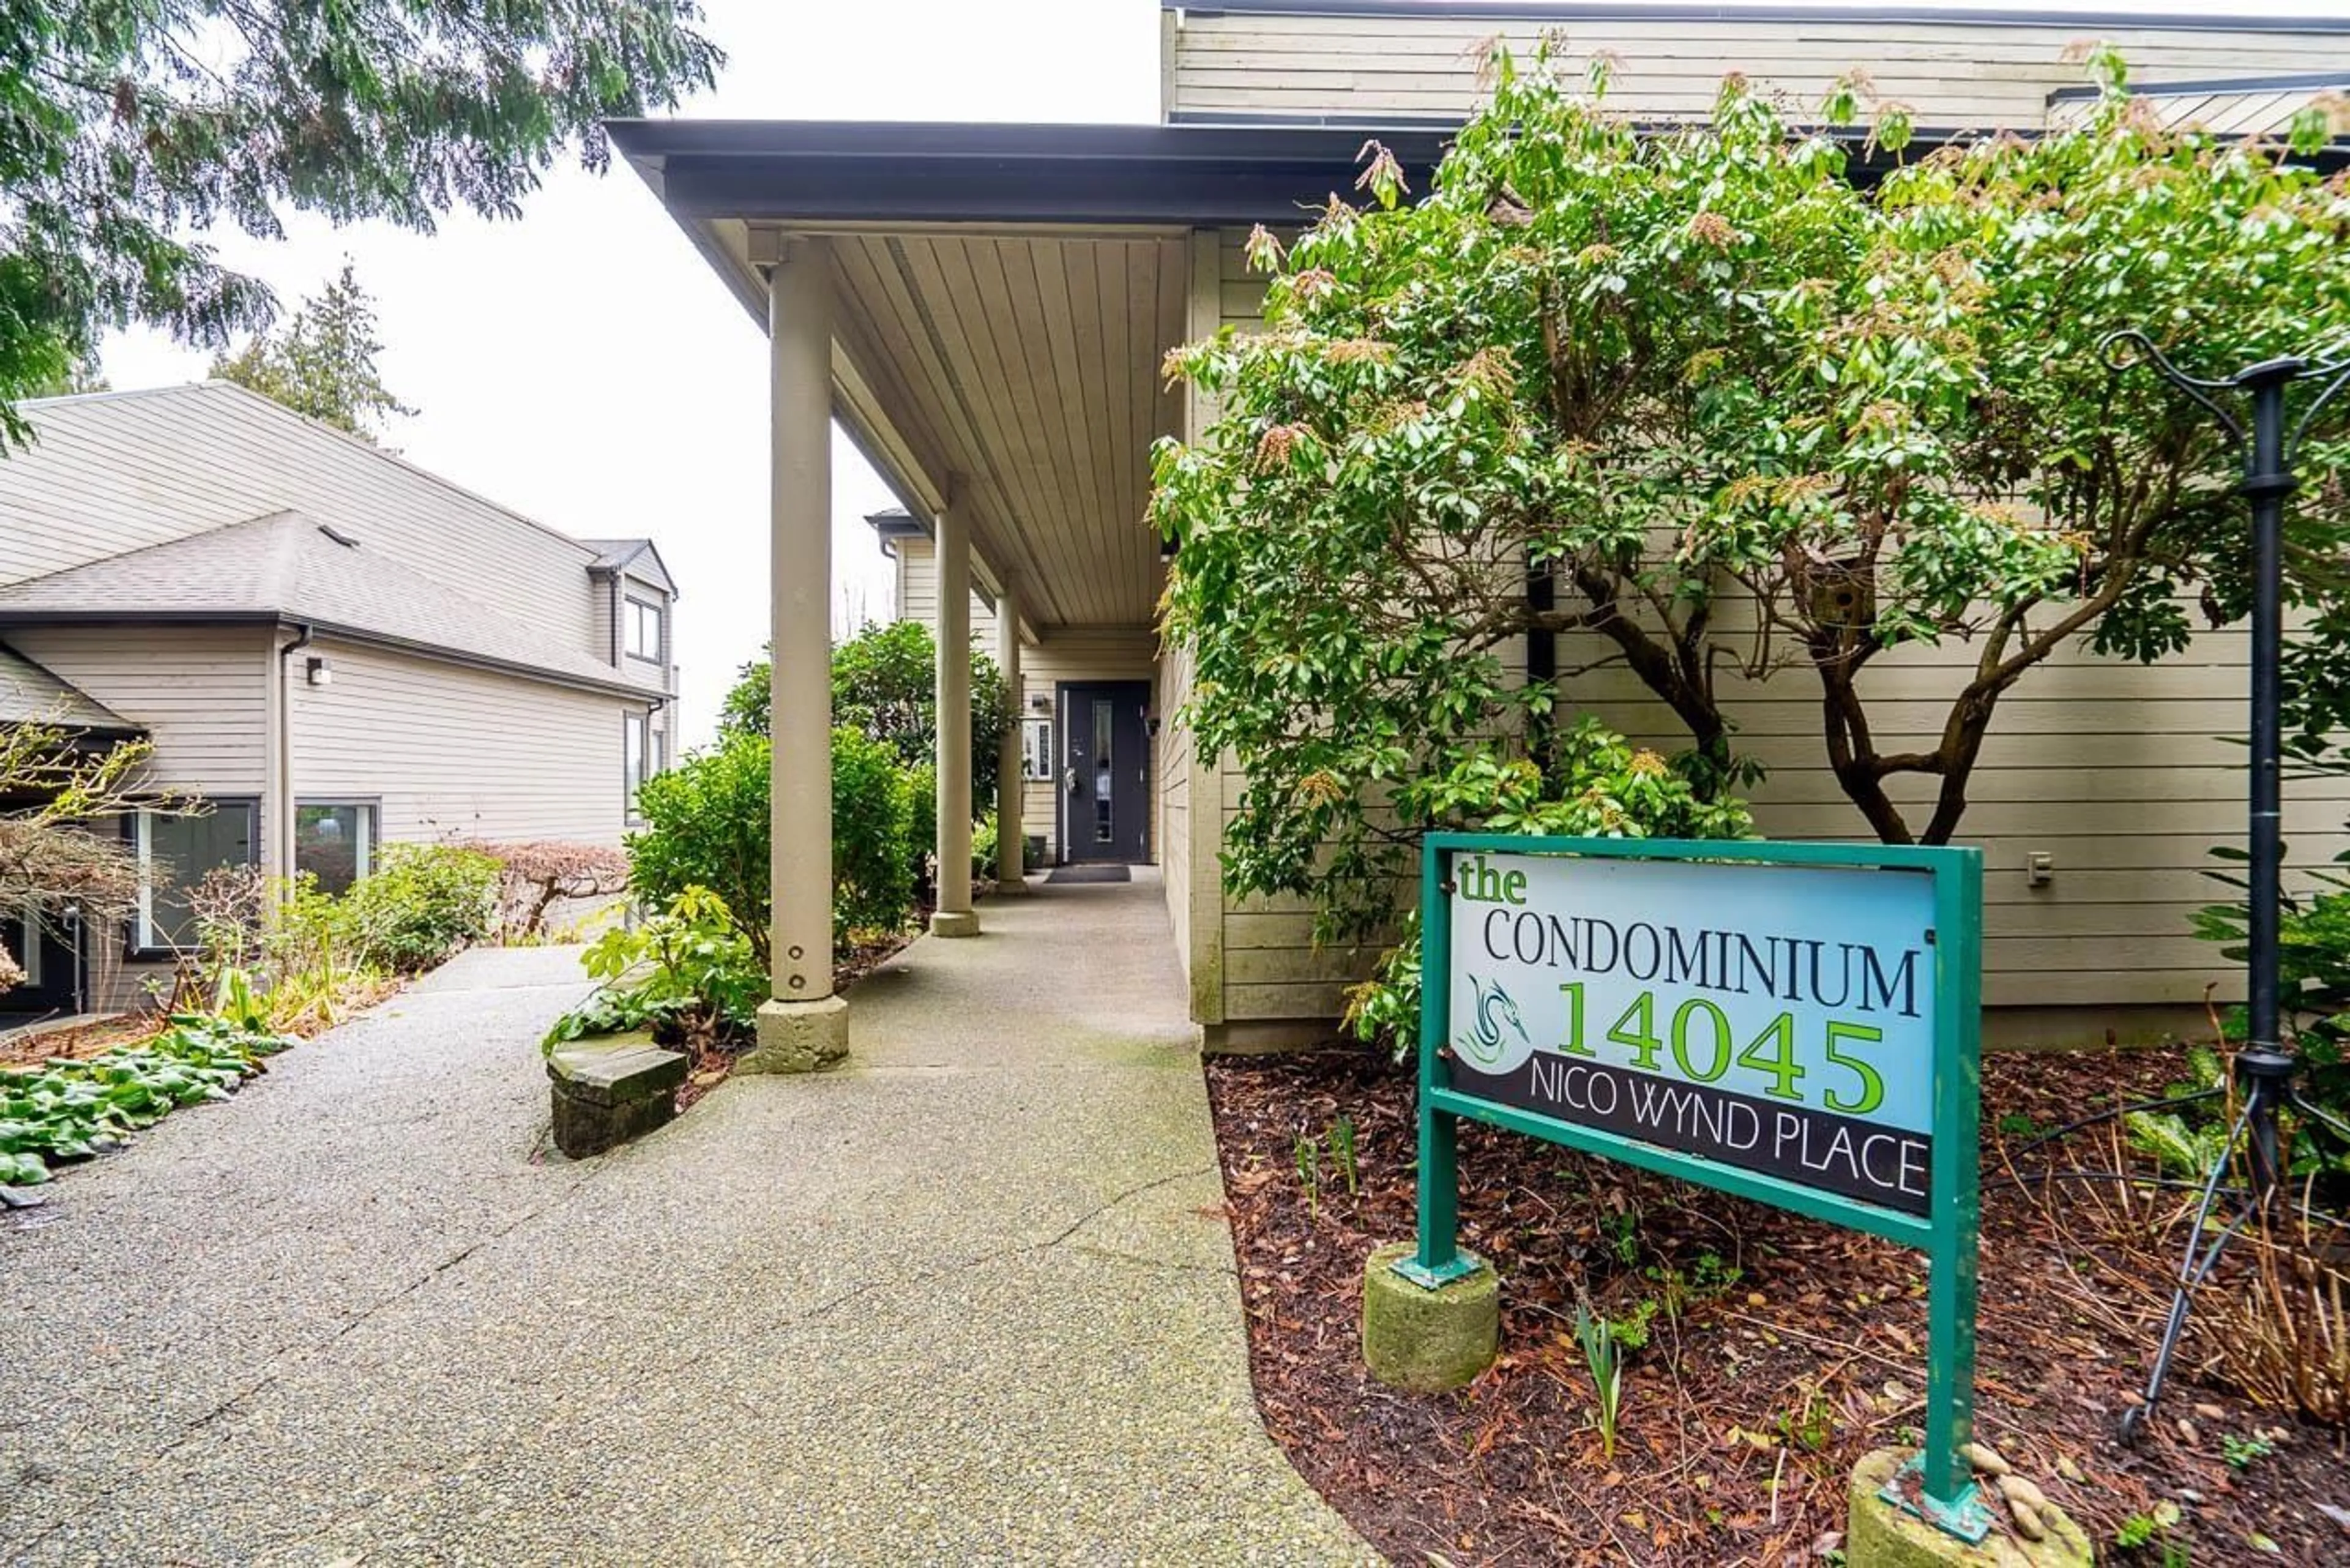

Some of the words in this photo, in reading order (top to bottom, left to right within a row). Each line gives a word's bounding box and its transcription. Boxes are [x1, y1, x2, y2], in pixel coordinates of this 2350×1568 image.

[1458, 856, 1527, 904] the
[1485, 909, 1920, 1018] CONDOMINIUM
[1559, 982, 1884, 1114] 14045
[1532, 1058, 1616, 1114] NICO
[1628, 1079, 1759, 1149] WYND
[1775, 1113, 1928, 1196] PLACE
